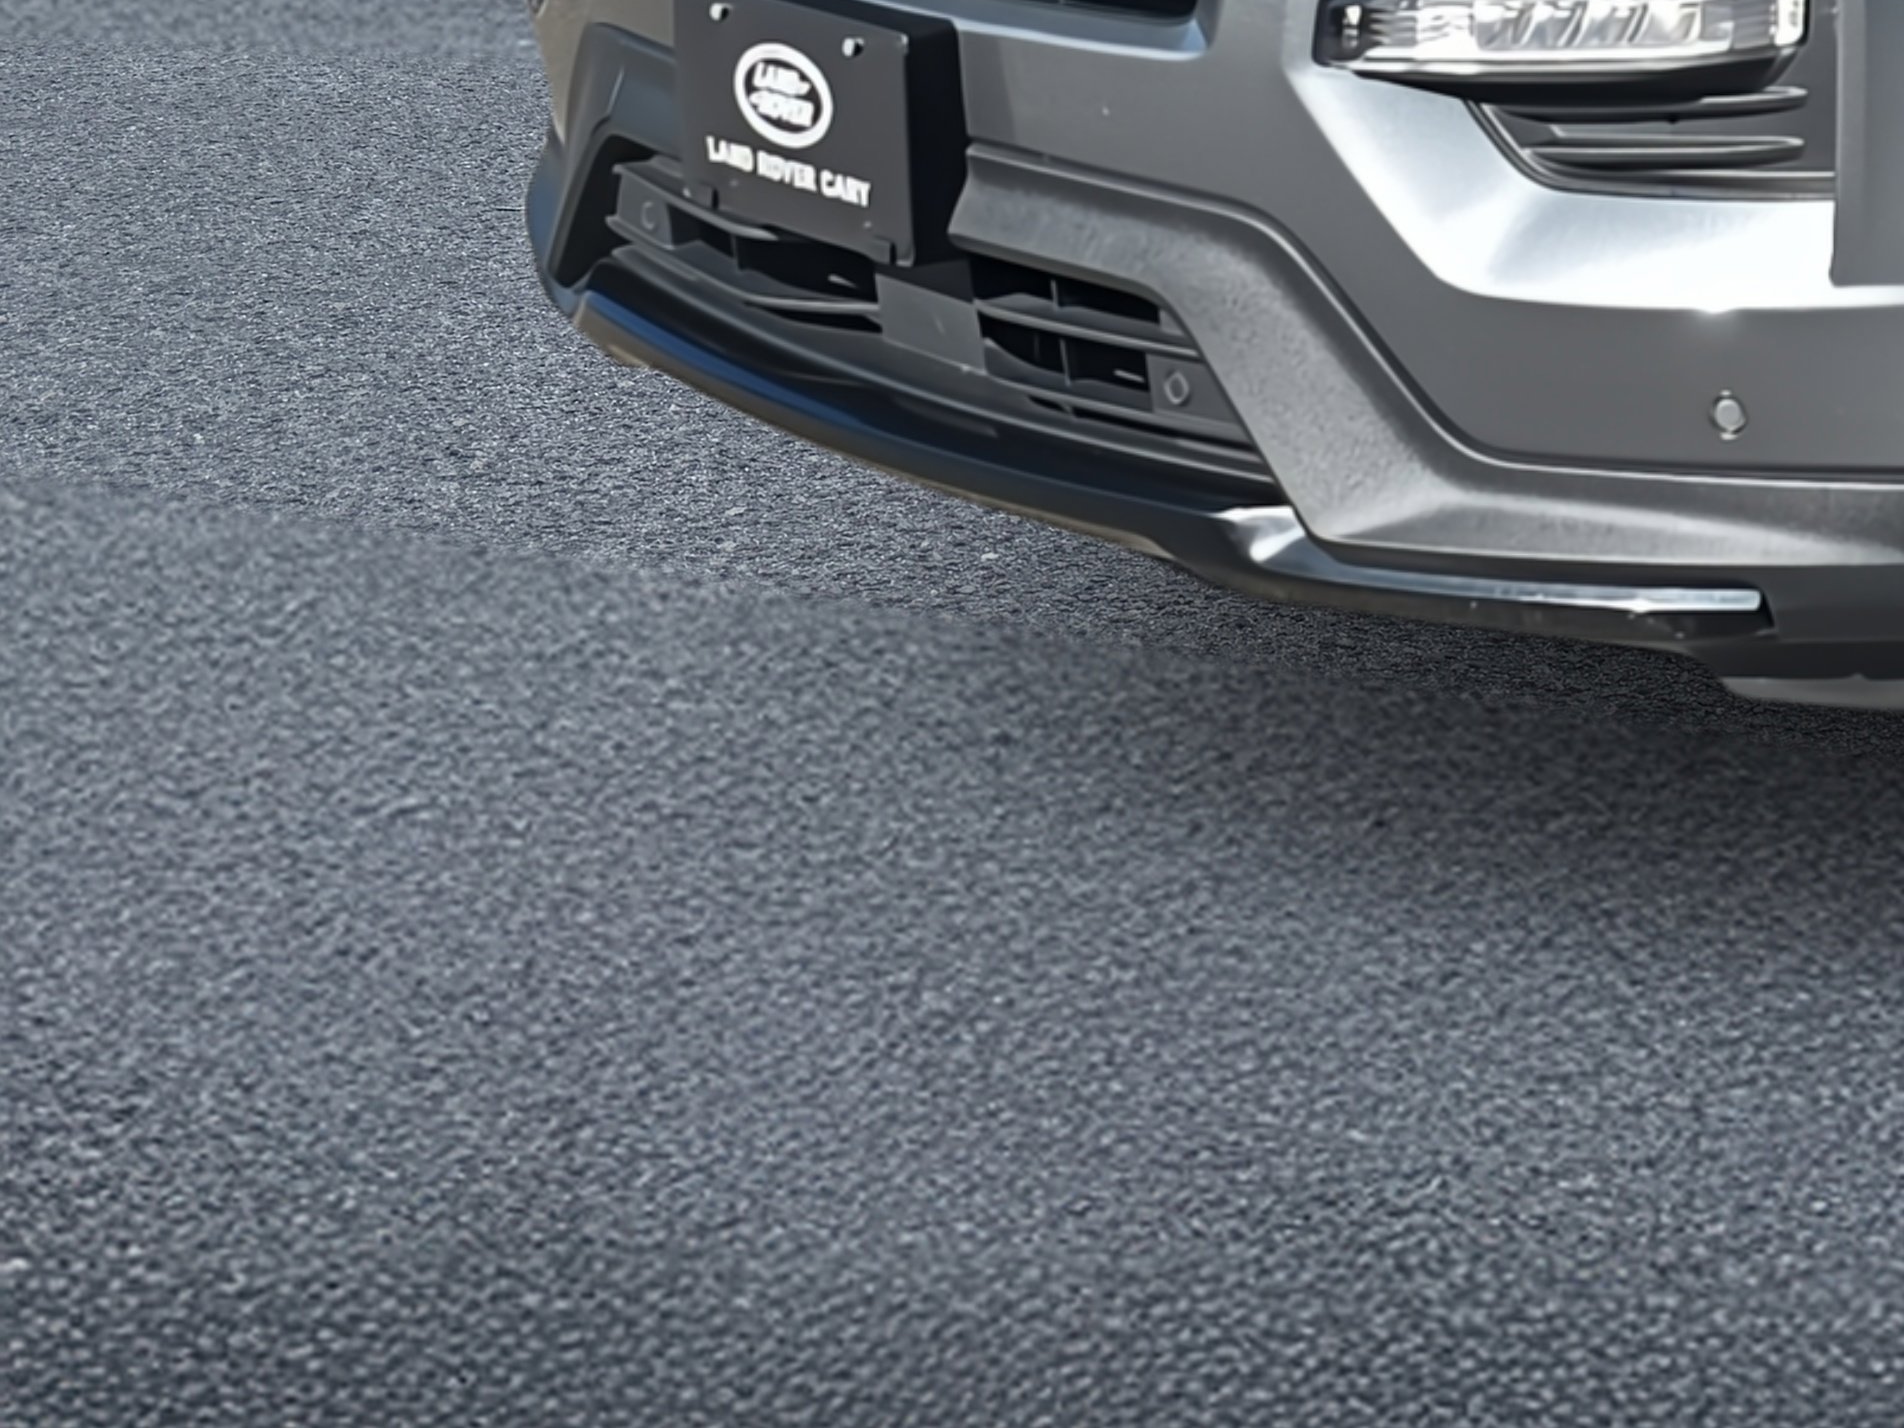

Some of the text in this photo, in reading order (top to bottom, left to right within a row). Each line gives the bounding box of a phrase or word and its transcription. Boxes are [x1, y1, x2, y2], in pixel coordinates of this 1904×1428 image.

[706, 136, 871, 207] LAND ROVER CARY
